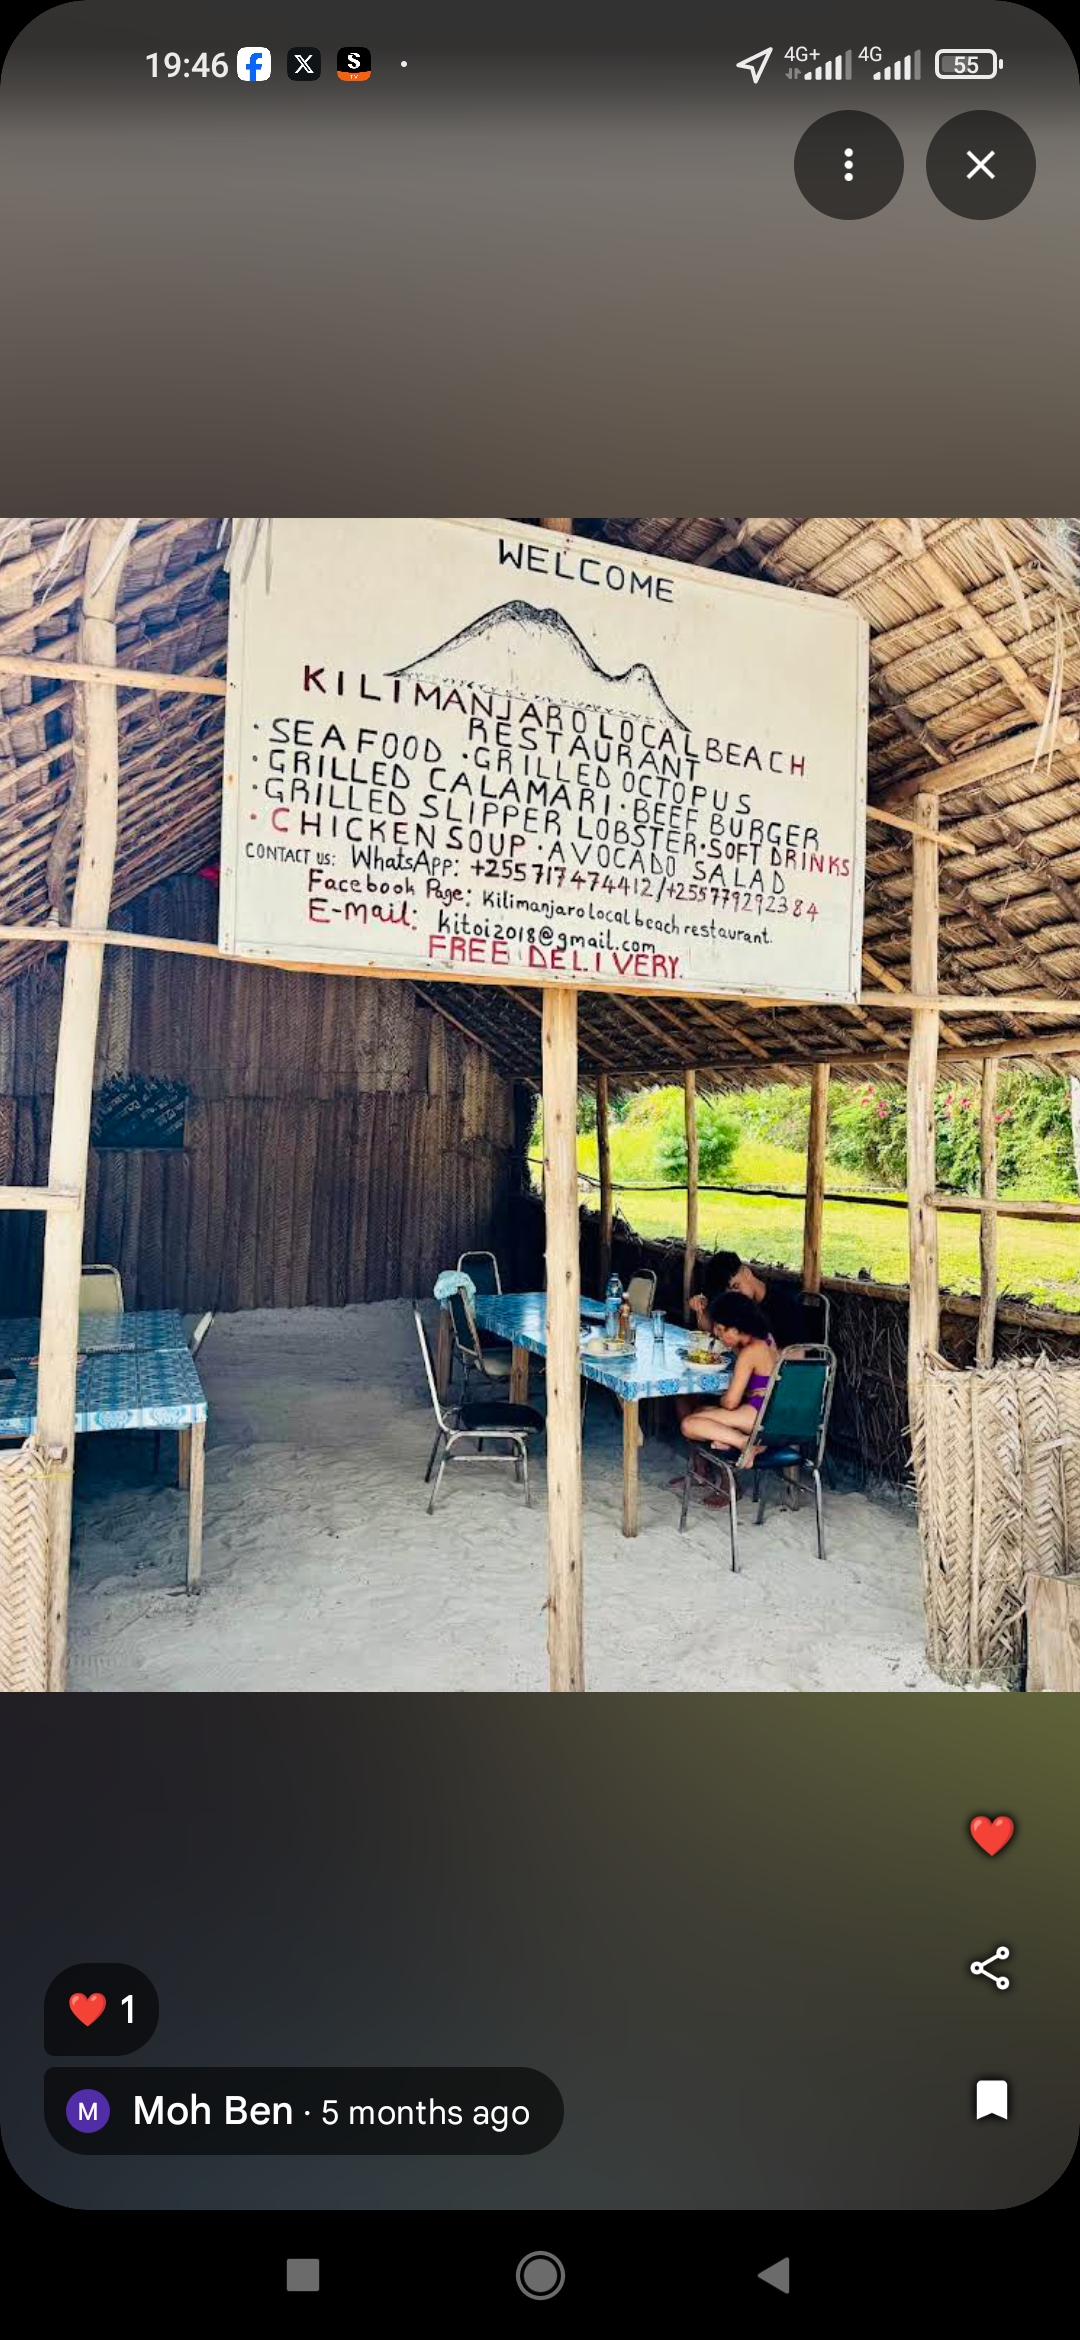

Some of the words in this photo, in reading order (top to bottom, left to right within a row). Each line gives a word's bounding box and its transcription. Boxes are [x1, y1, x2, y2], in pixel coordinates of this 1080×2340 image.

[499, 539, 673, 602] WELCOME
[303, 665, 587, 733] KILIMANJARO
[599, 714, 698, 757] LOCAL
[706, 738, 806, 776] BEACH
[469, 718, 700, 781] RESTAURANT
[269, 750, 410, 790] GRILLED
[429, 767, 610, 815] CALAMARI
[634, 798, 699, 832] BEEF
[710, 813, 819, 851] BURGER
[474, 746, 610, 788] GRILLED
[622, 771, 751, 815] OCTOPUS
[265, 778, 407, 816] GRILLED
[419, 794, 561, 835] SLIPPER
[578, 816, 697, 857] LOBSTER
[707, 838, 762, 866] SOFT
[770, 846, 850, 876] DRINKS
[271, 808, 435, 848] CHICKEN
[446, 826, 525, 858] SOUP
[548, 840, 676, 877] AVOCADO
[693, 860, 786, 894] SALAD
[245, 842, 311, 864] CONTACT
[352, 844, 459, 876] WhatsApp:
[308, 868, 415, 895] Facebook
[426, 878, 472, 906] Page:
[428, 934, 508, 965] FREE
[437, 908, 655, 954] kitoi2018@gmail.com
